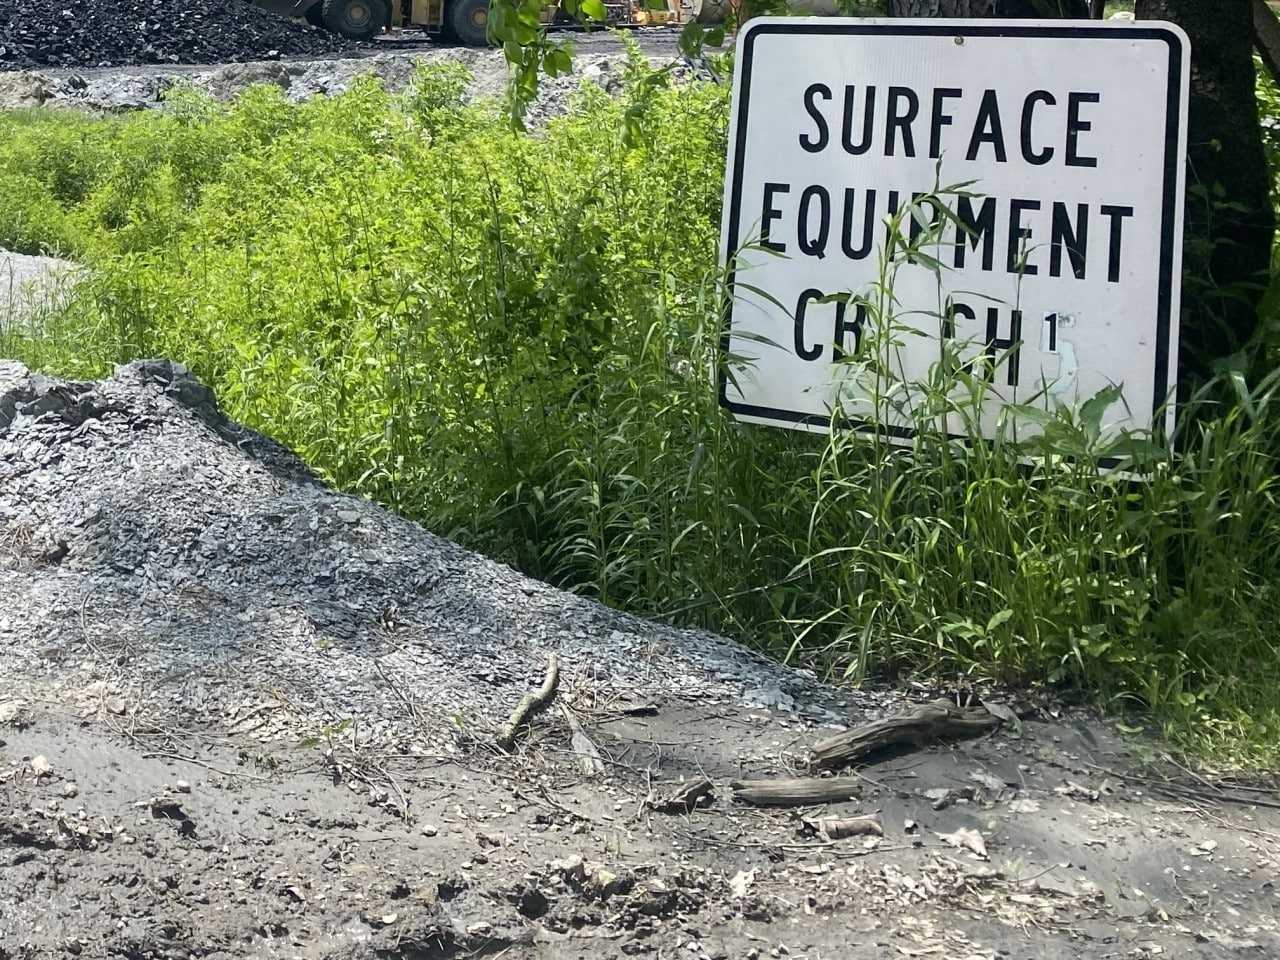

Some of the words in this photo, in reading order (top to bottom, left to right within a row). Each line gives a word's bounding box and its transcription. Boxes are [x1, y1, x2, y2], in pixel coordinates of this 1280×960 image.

[799, 83, 1101, 168] SURFACE
[760, 182, 1134, 283] EQUIPMENT
[942, 303, 1023, 386] CH
